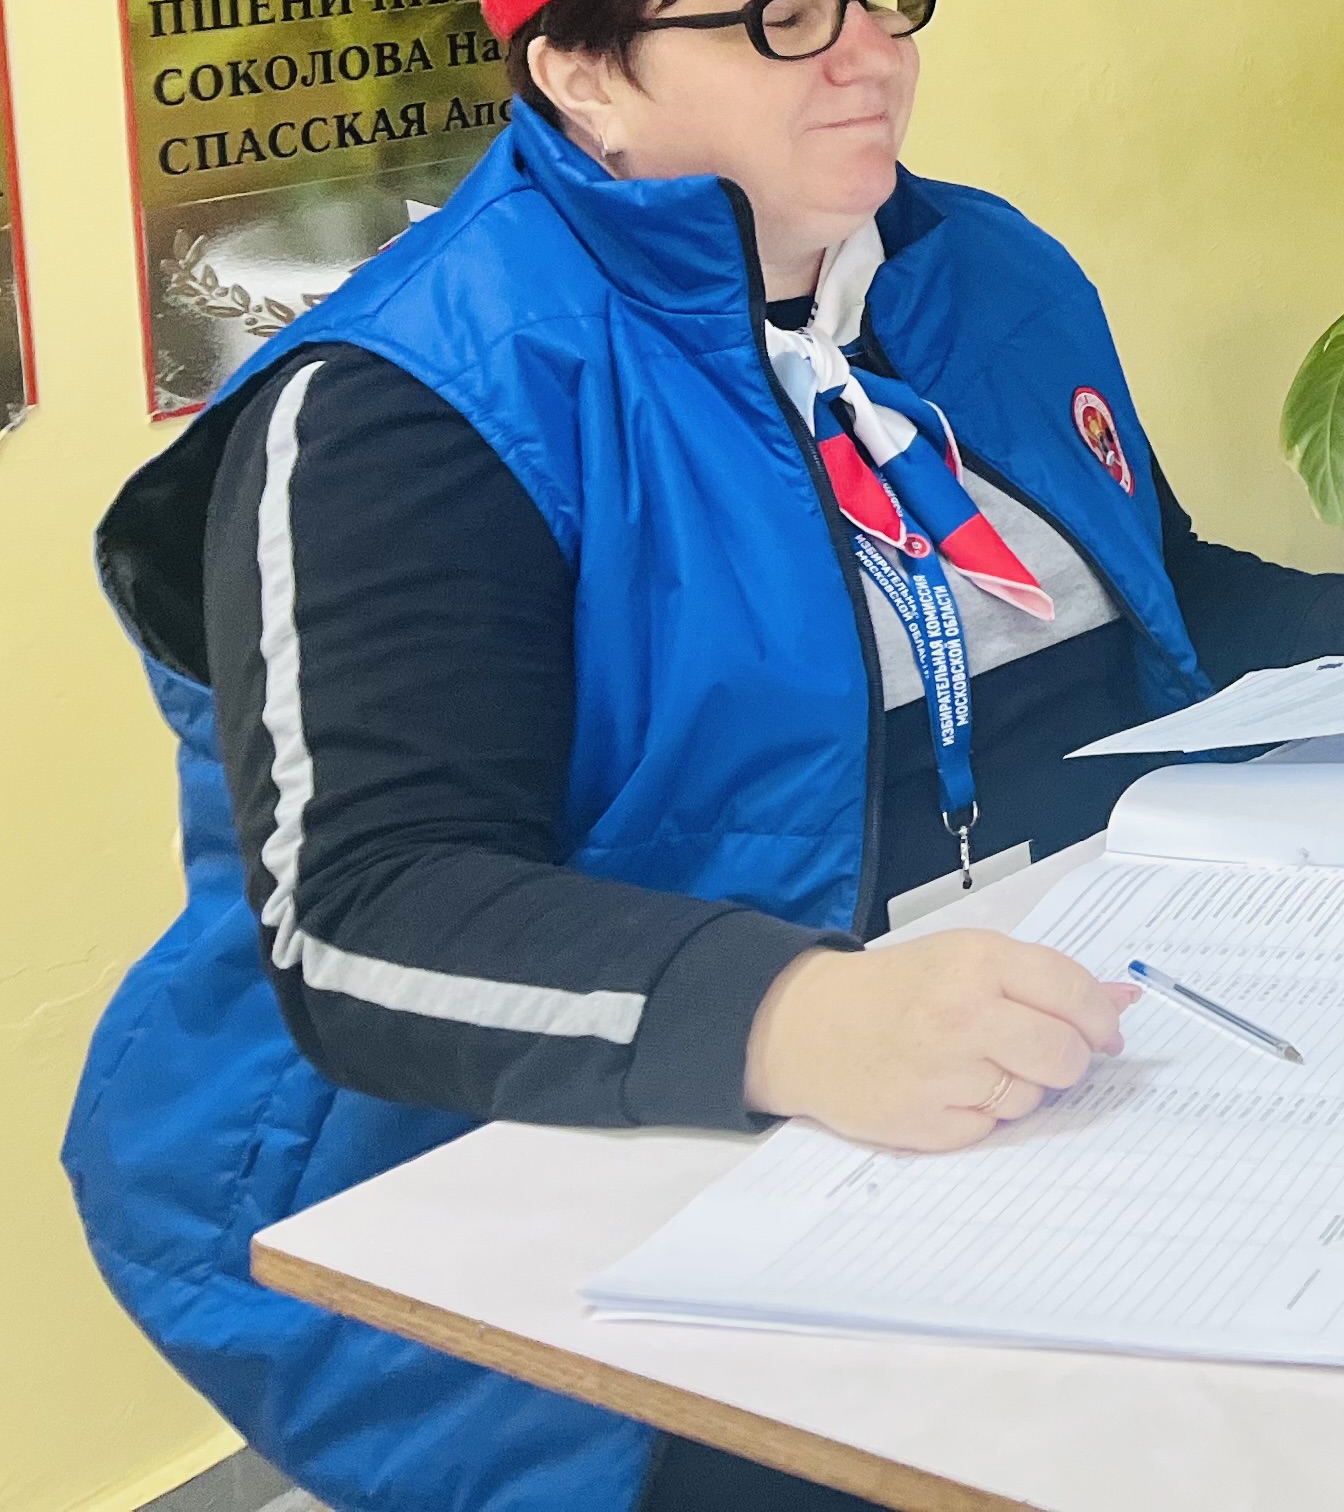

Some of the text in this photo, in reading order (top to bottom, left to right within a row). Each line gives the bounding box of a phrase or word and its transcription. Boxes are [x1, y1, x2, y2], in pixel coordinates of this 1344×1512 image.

[154, 38, 433, 105] СОКОЛОВА
[159, 102, 427, 175] СПАССКАЯ
[913, 574, 955, 747] ИЗБИРАТЕЛЬНАЯ КОМИССИЯ
[932, 585, 970, 728] МОСКОВСКОЙ ОБЛАСТИ
